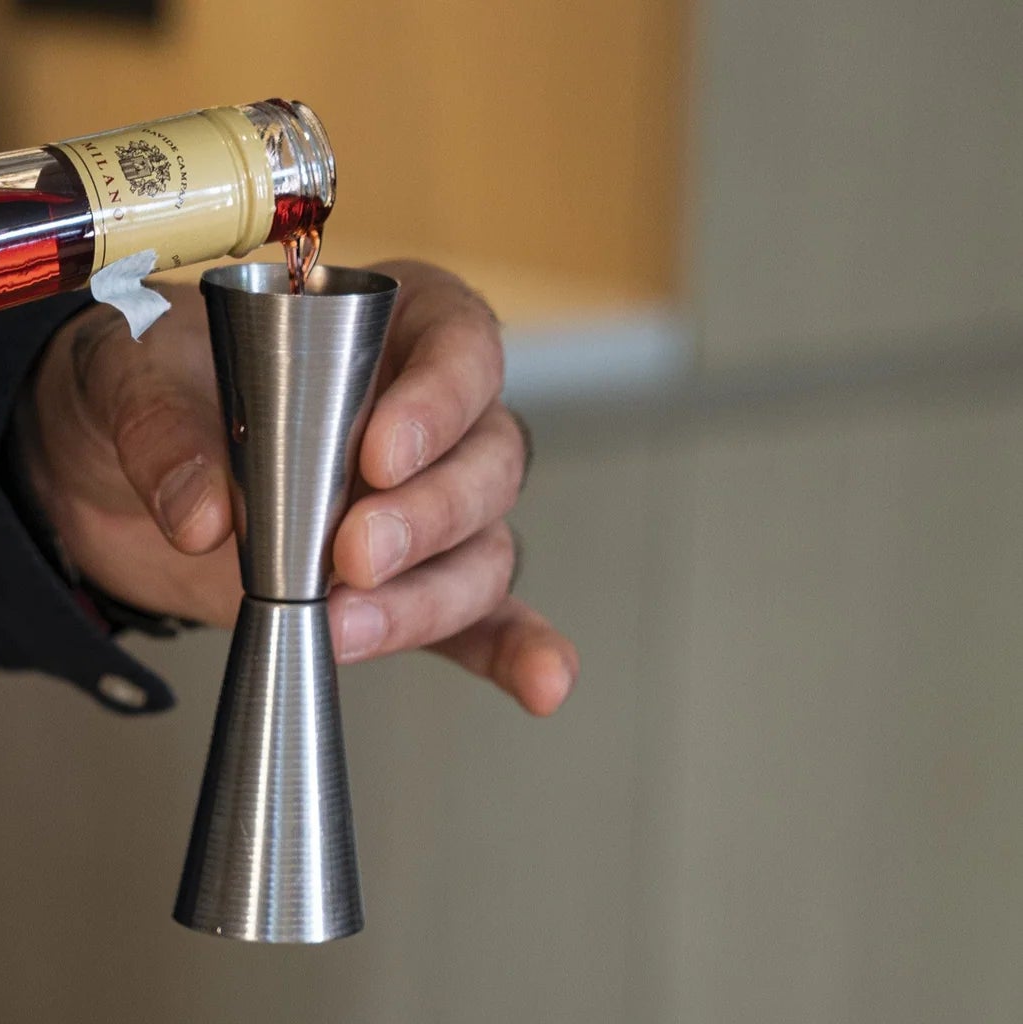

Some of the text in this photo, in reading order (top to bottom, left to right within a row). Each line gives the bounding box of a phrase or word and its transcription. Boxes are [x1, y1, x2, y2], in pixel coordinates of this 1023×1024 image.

[81, 141, 125, 221] MILANO
[141, 127, 189, 210] DAVIDE CAMPARI
